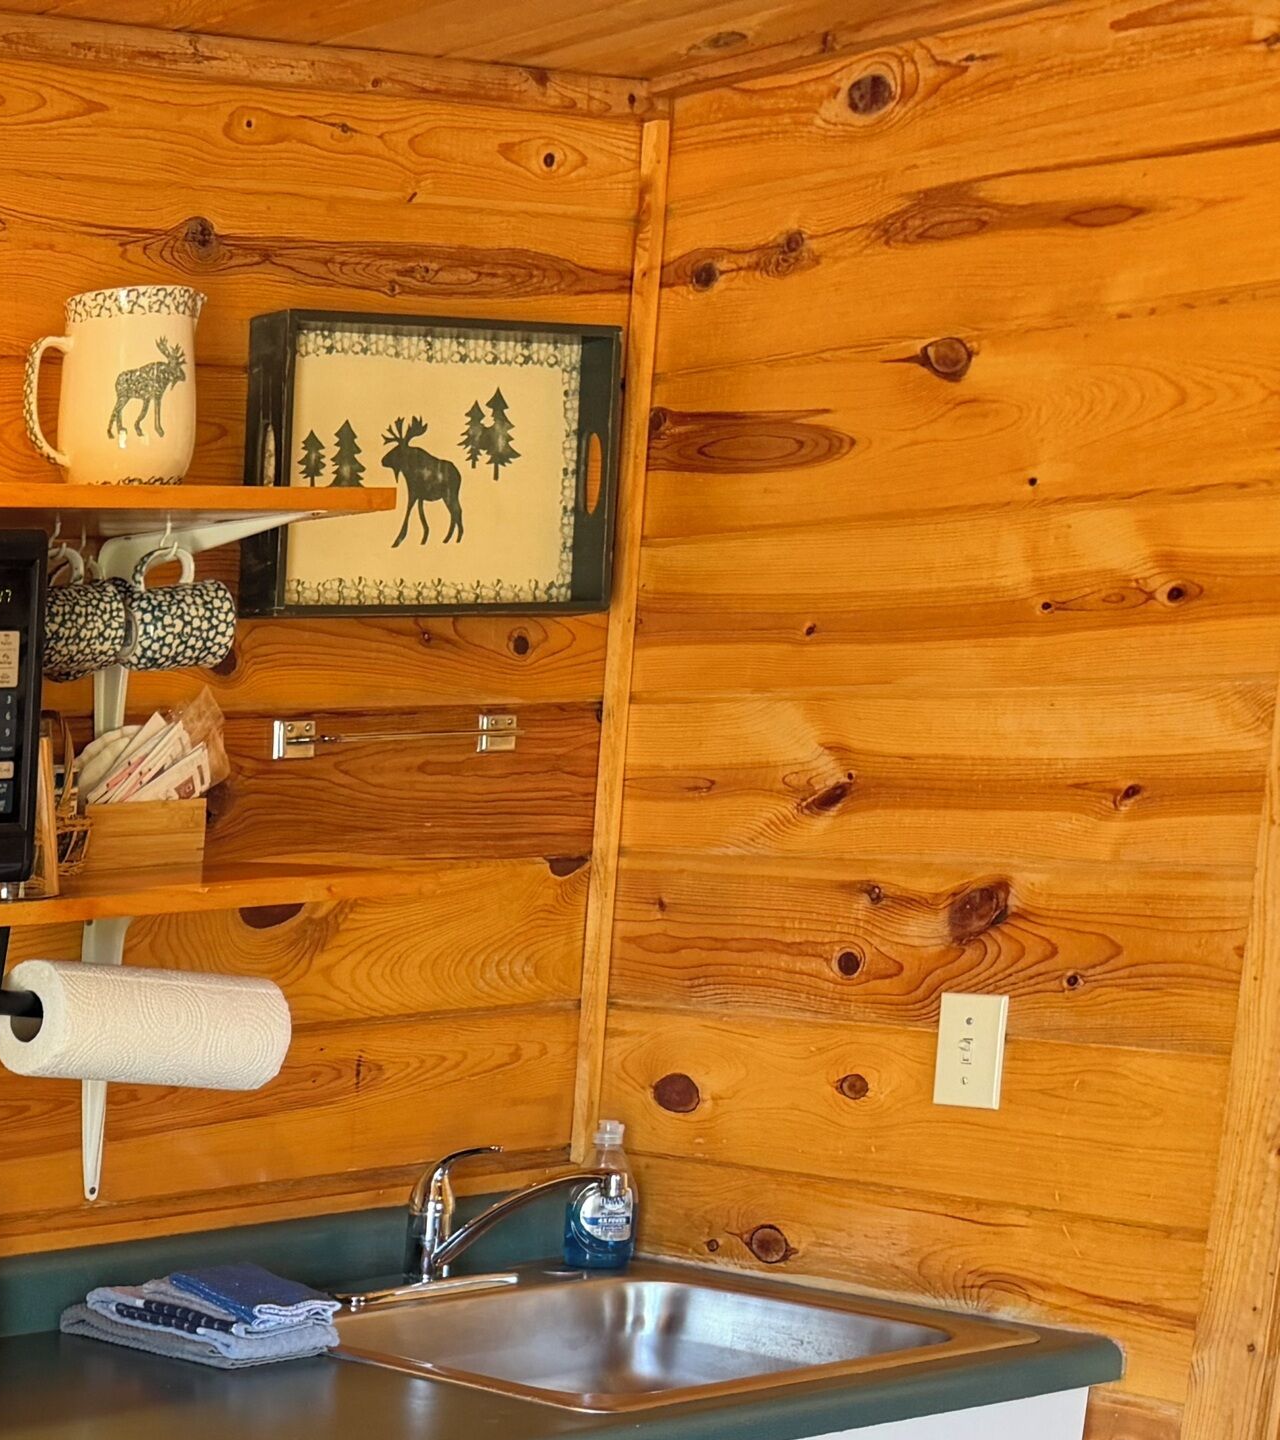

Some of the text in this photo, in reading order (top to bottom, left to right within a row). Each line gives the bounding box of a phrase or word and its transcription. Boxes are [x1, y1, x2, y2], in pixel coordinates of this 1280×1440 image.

[6, 695, 12, 704] 3
[5, 710, 11, 721] 6
[4, 727, 11, 737] 9
